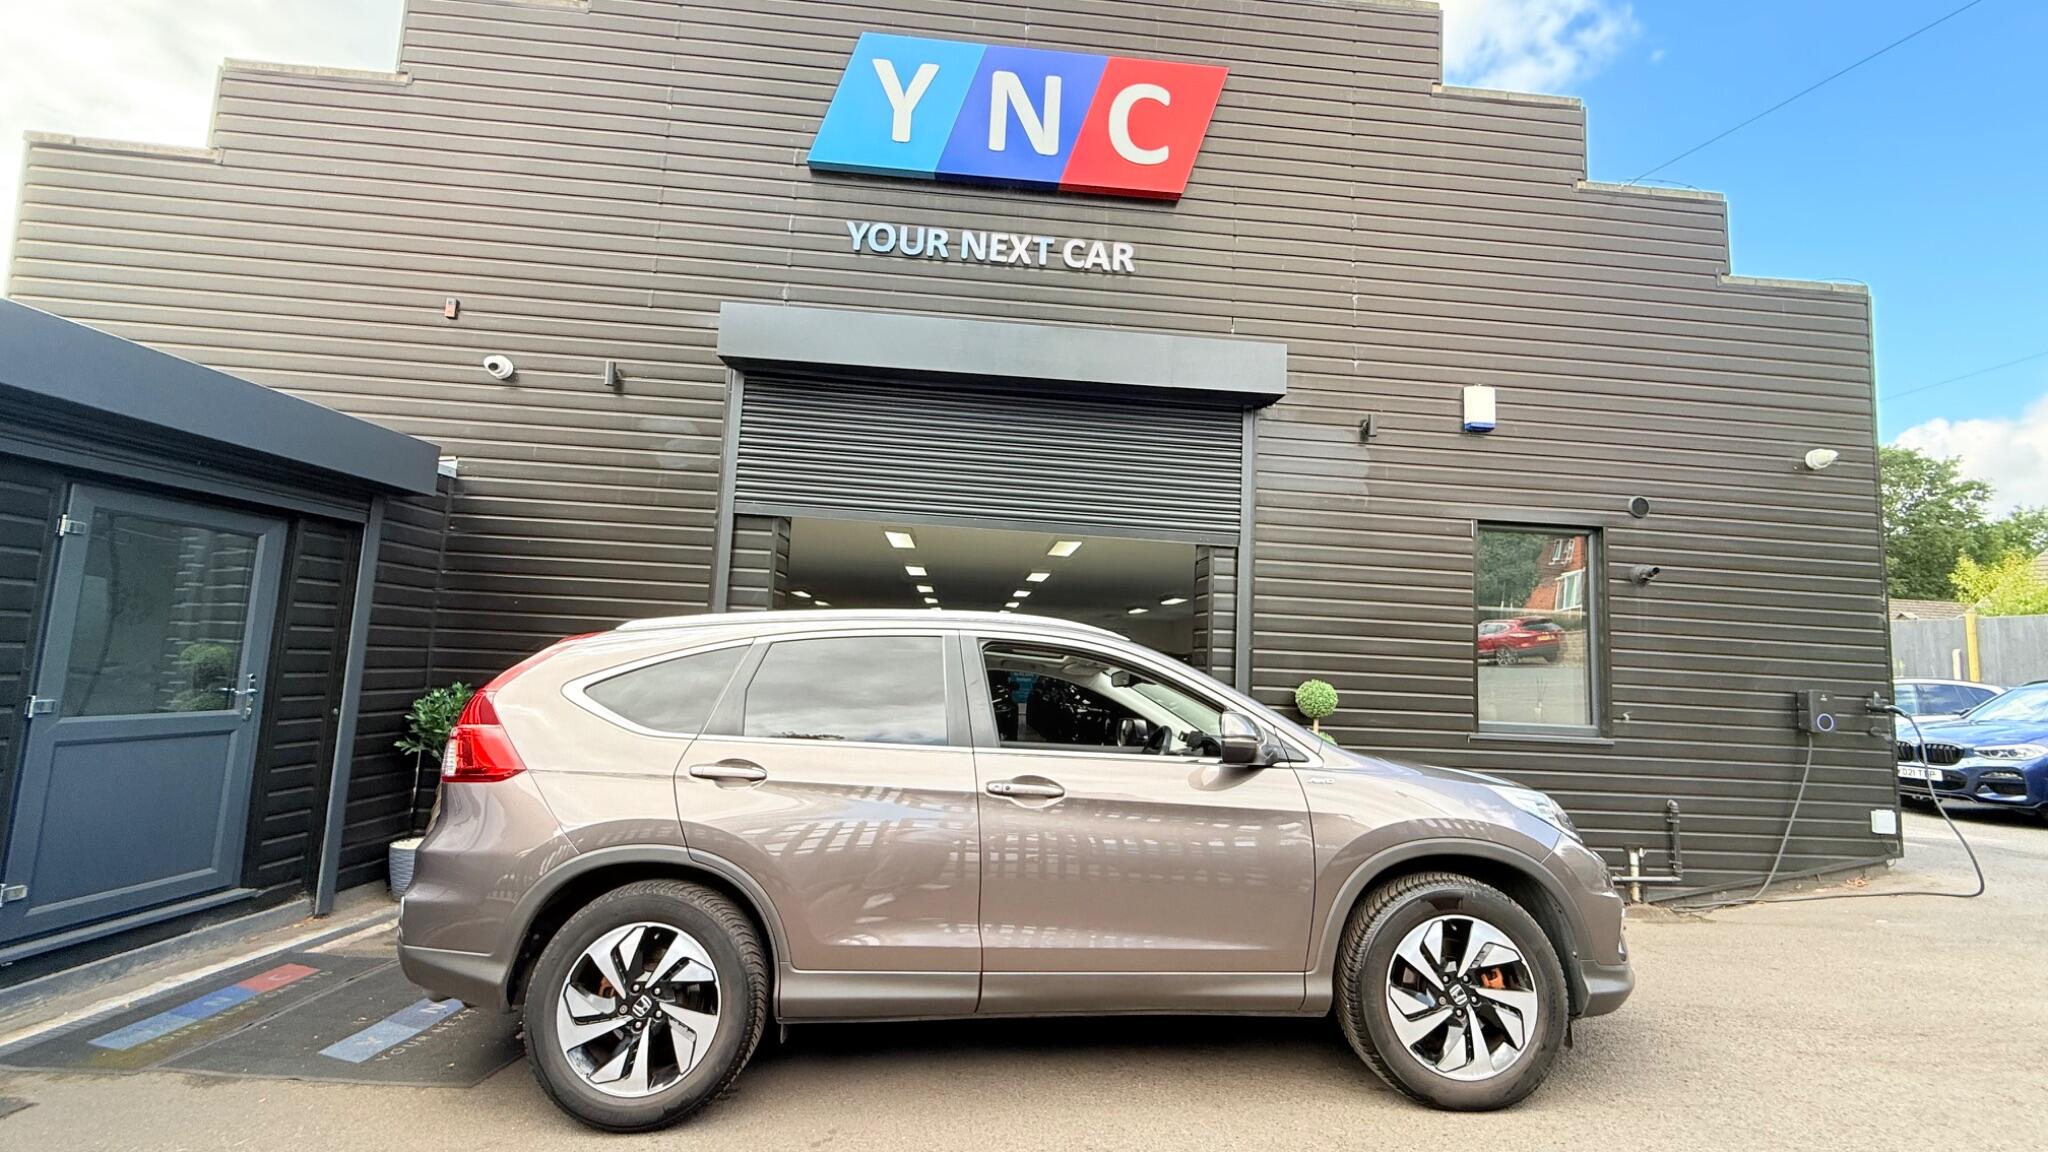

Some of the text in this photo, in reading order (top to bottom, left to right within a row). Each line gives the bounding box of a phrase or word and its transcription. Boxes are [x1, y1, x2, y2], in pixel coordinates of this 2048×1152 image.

[872, 58, 1171, 165] YNC
[846, 220, 1135, 273] YOUR NEXT CAR
